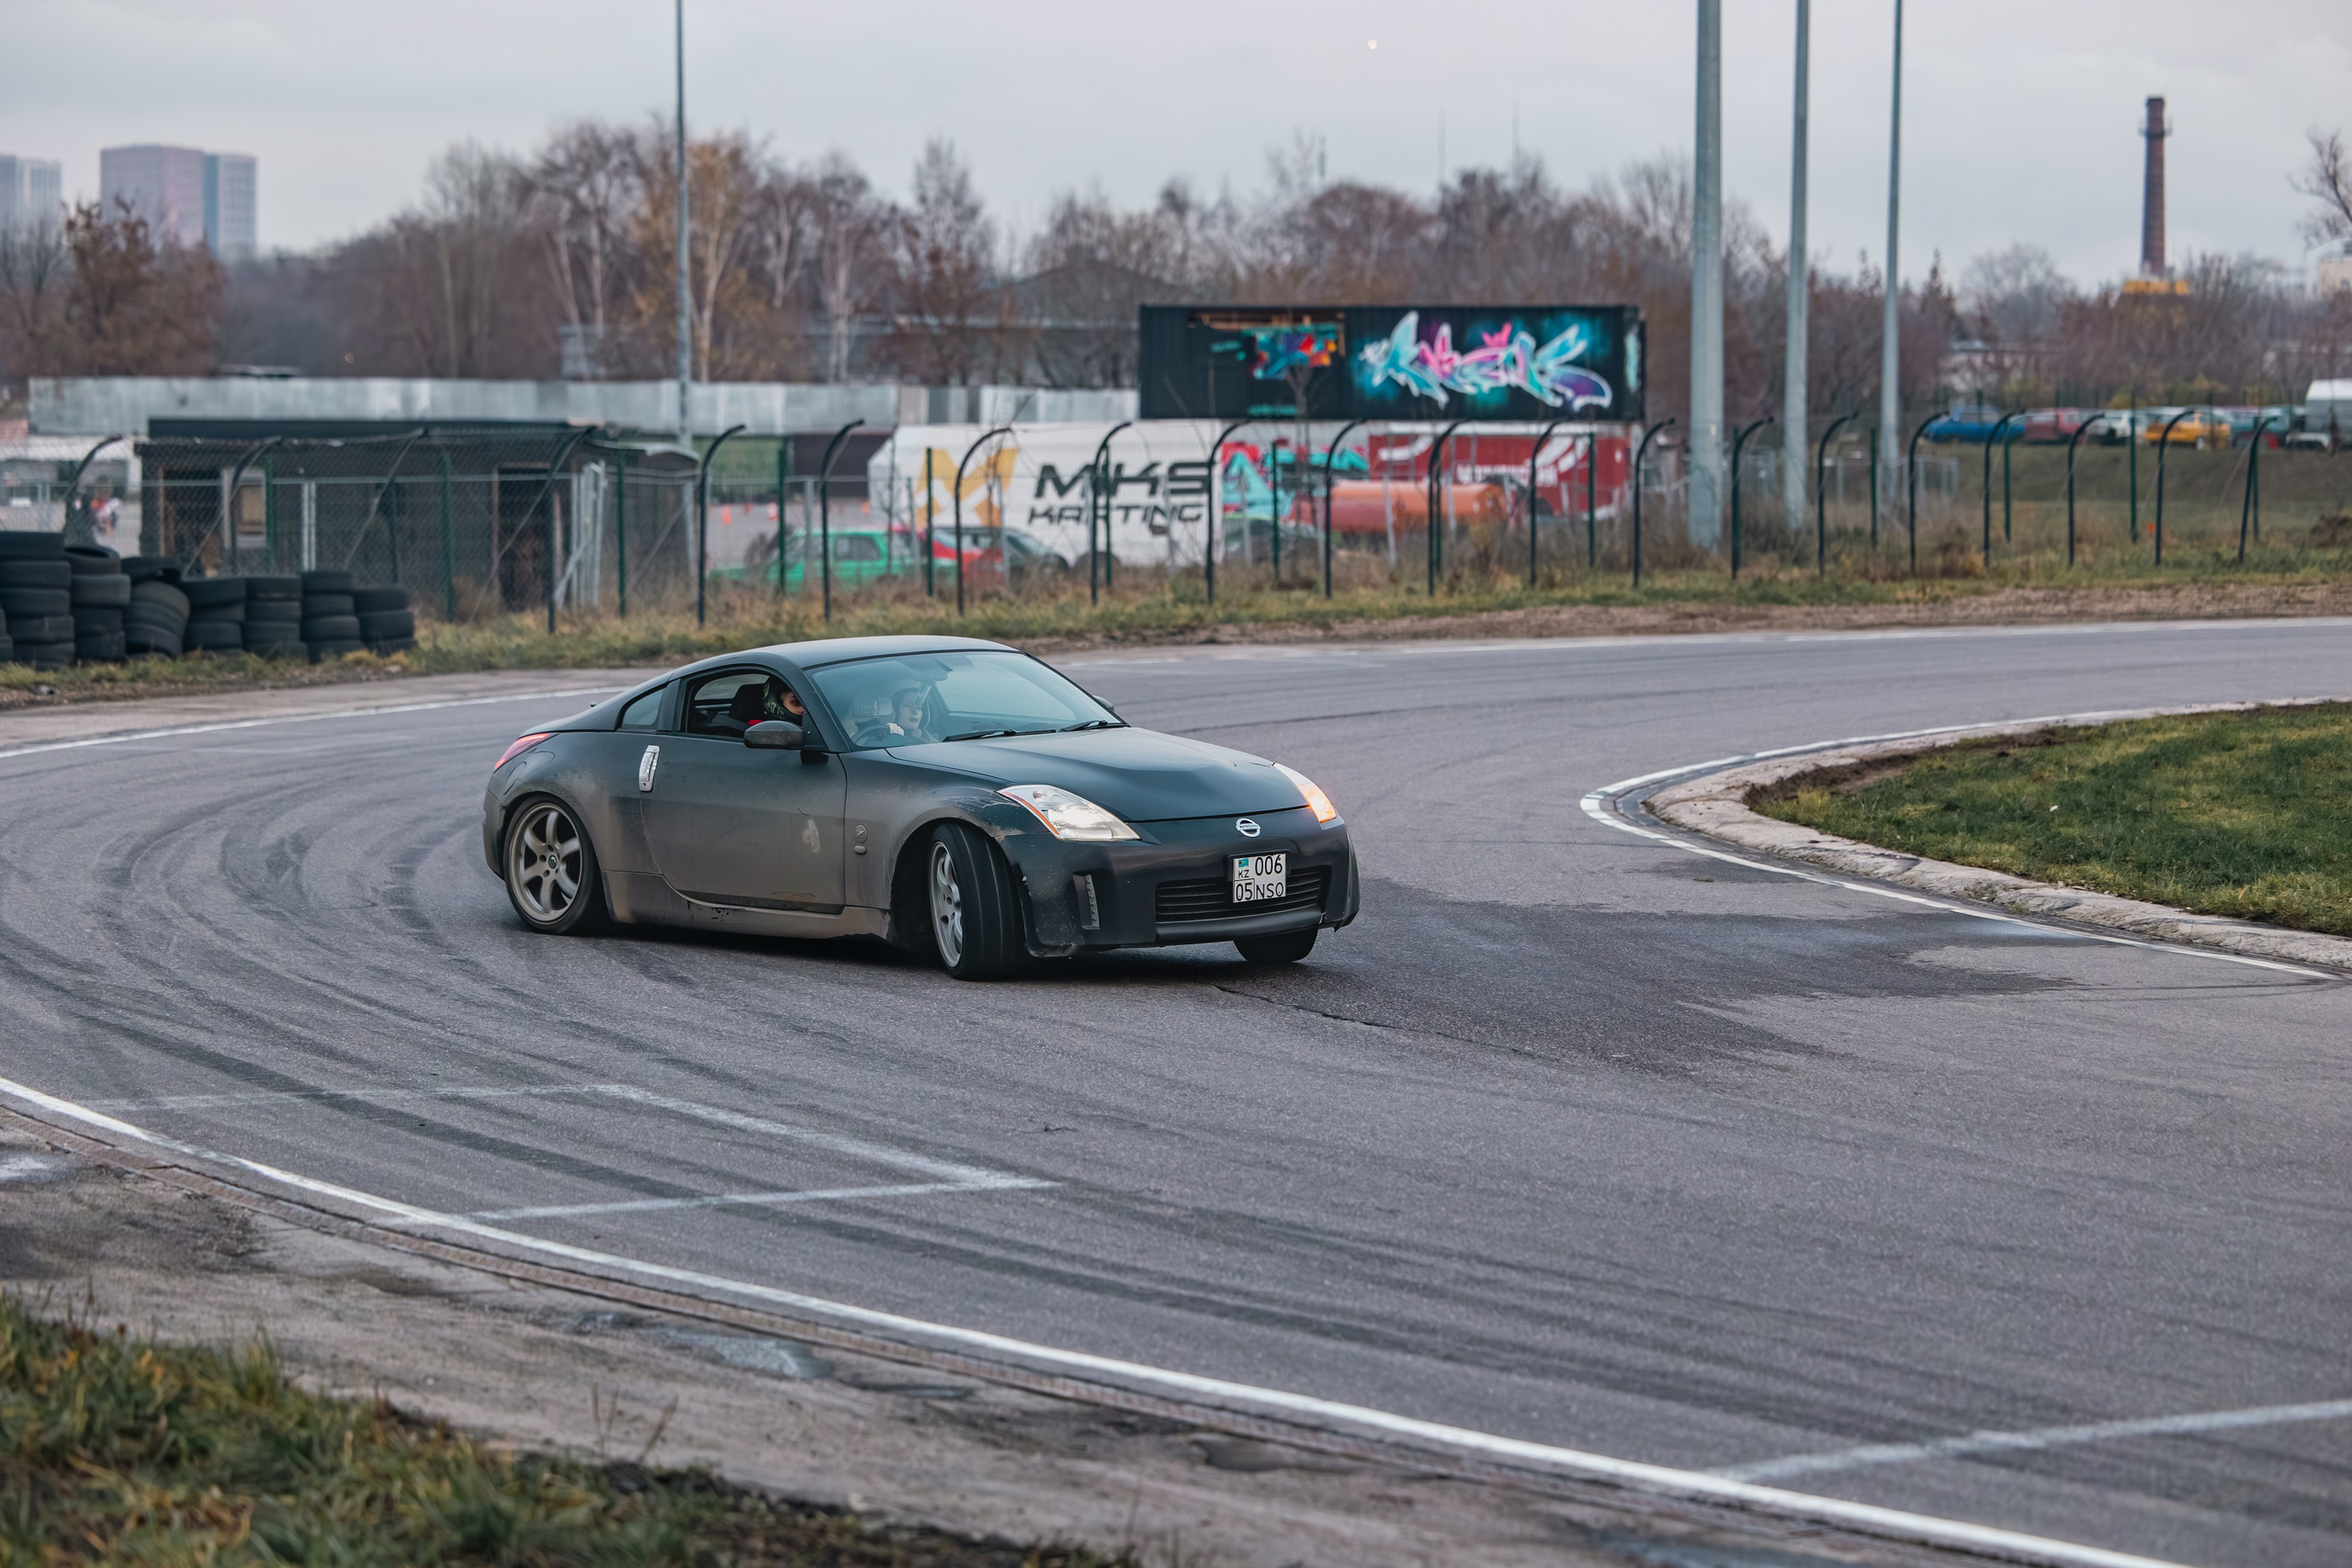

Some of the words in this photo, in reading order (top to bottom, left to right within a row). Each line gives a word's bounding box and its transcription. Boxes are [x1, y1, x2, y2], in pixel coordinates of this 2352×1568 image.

[1238, 869, 1250, 878] KZ
[1255, 854, 1283, 876] 006
[1236, 882, 1252, 901] 05
[1256, 882, 1283, 900] NSO
